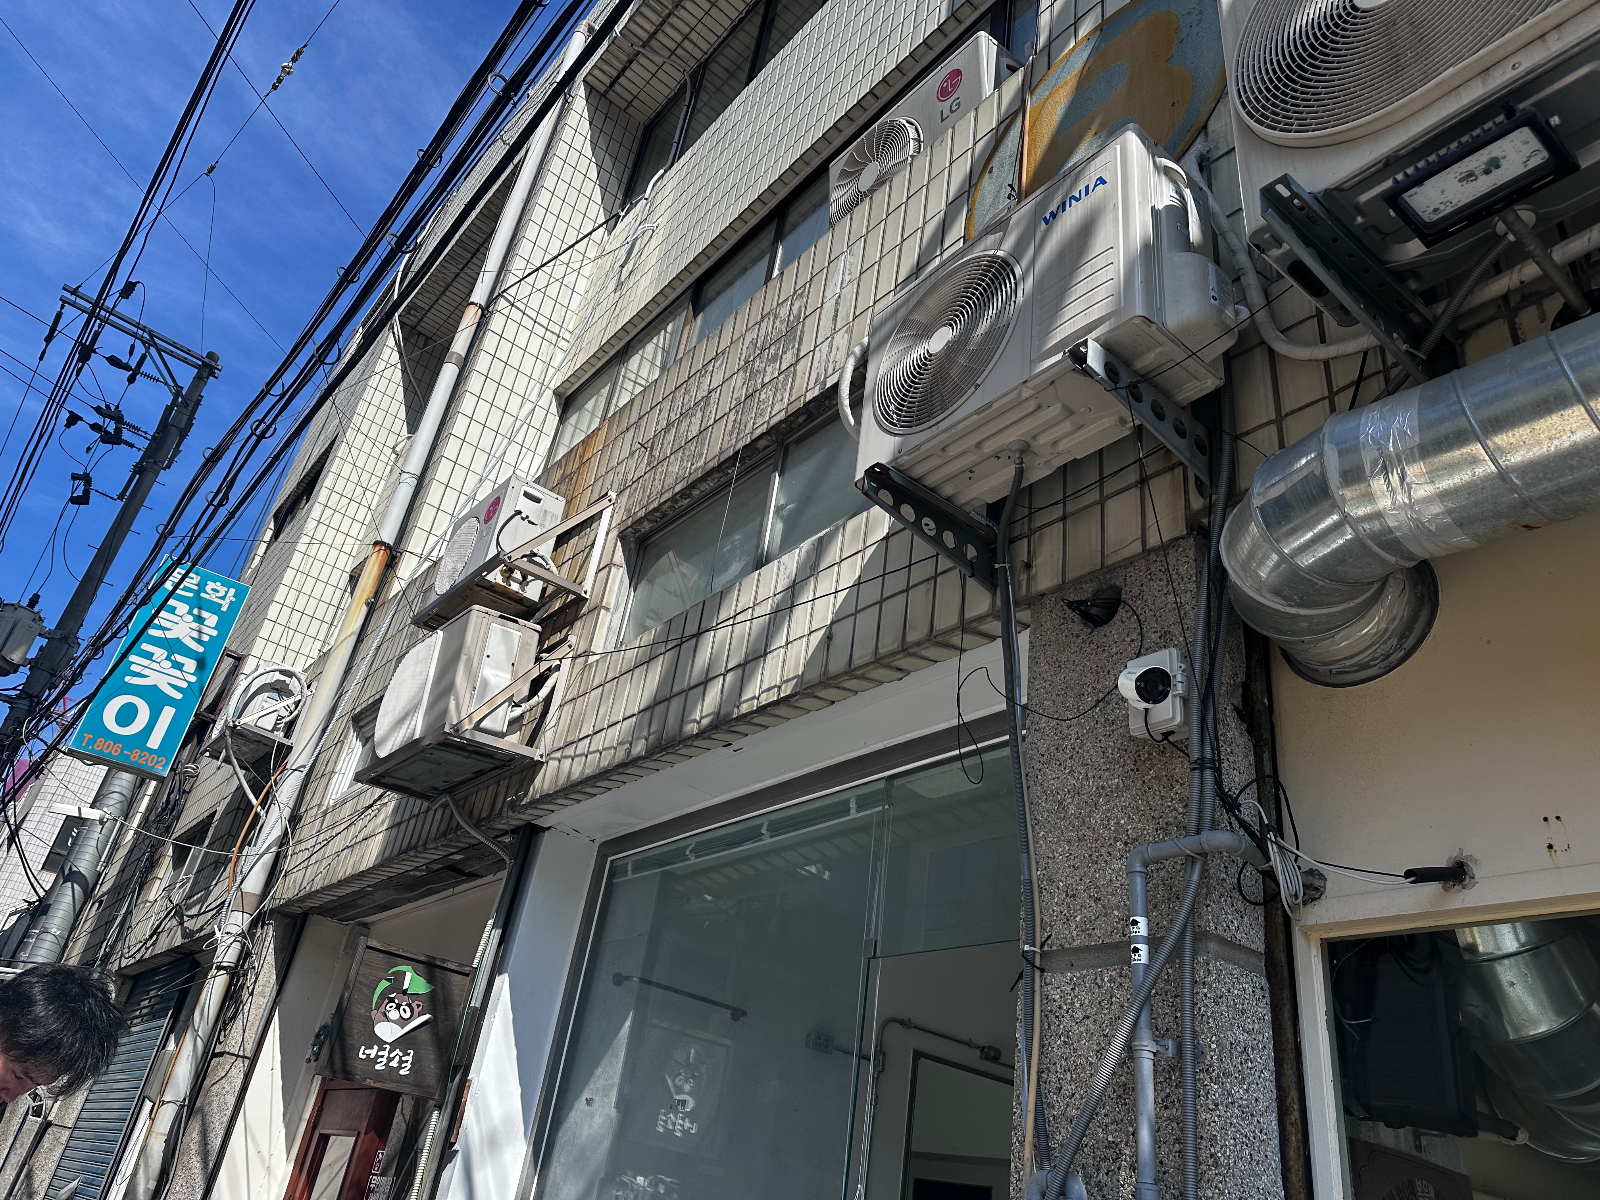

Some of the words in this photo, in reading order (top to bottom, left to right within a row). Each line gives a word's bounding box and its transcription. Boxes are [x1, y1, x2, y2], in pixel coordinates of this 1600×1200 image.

[939, 96, 961, 124] LG
[1042, 175, 1108, 226] WINIA
[164, 566, 236, 612] 문화
[81, 733, 167, 770] T.806-8202
[358, 1044, 414, 1076] 너굴소굴
